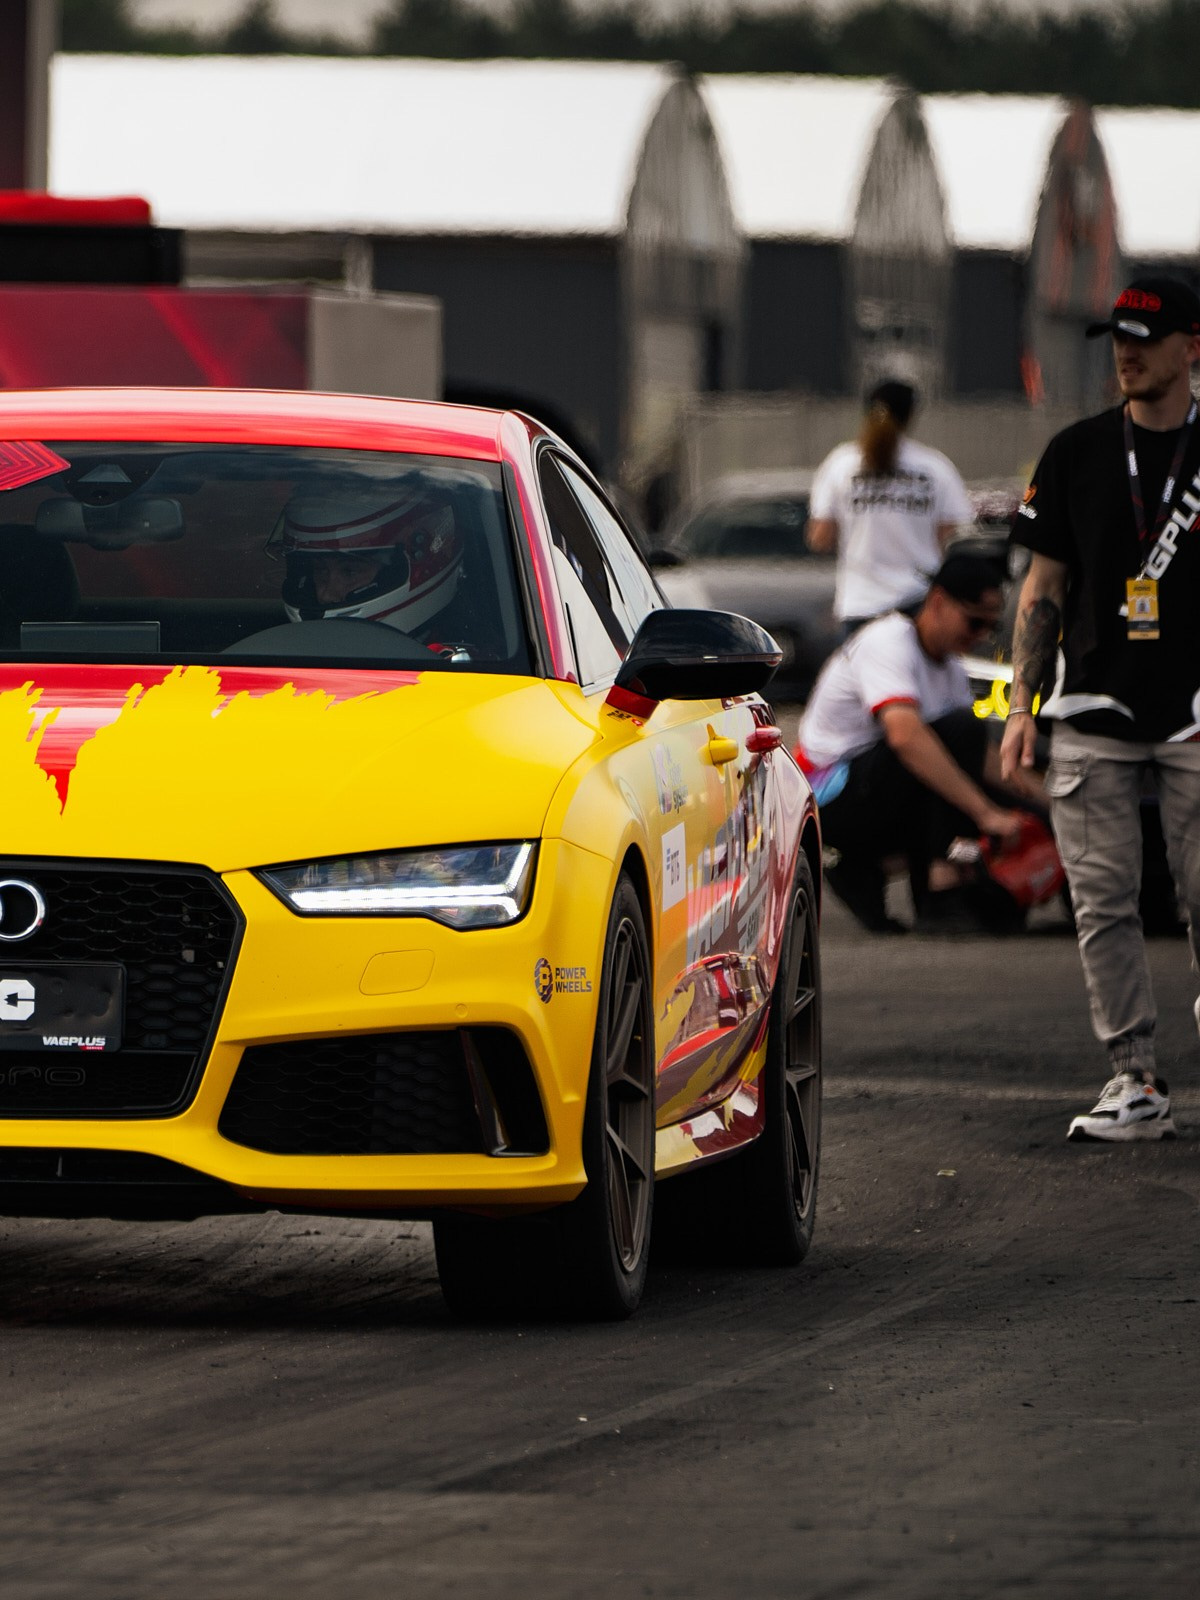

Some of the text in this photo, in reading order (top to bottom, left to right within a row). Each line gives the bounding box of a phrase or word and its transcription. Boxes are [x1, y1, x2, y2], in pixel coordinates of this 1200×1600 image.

[555, 967, 587, 980] POWER
[555, 980, 593, 993] WHEELS
[42, 1035, 106, 1047] VAGPLUS
